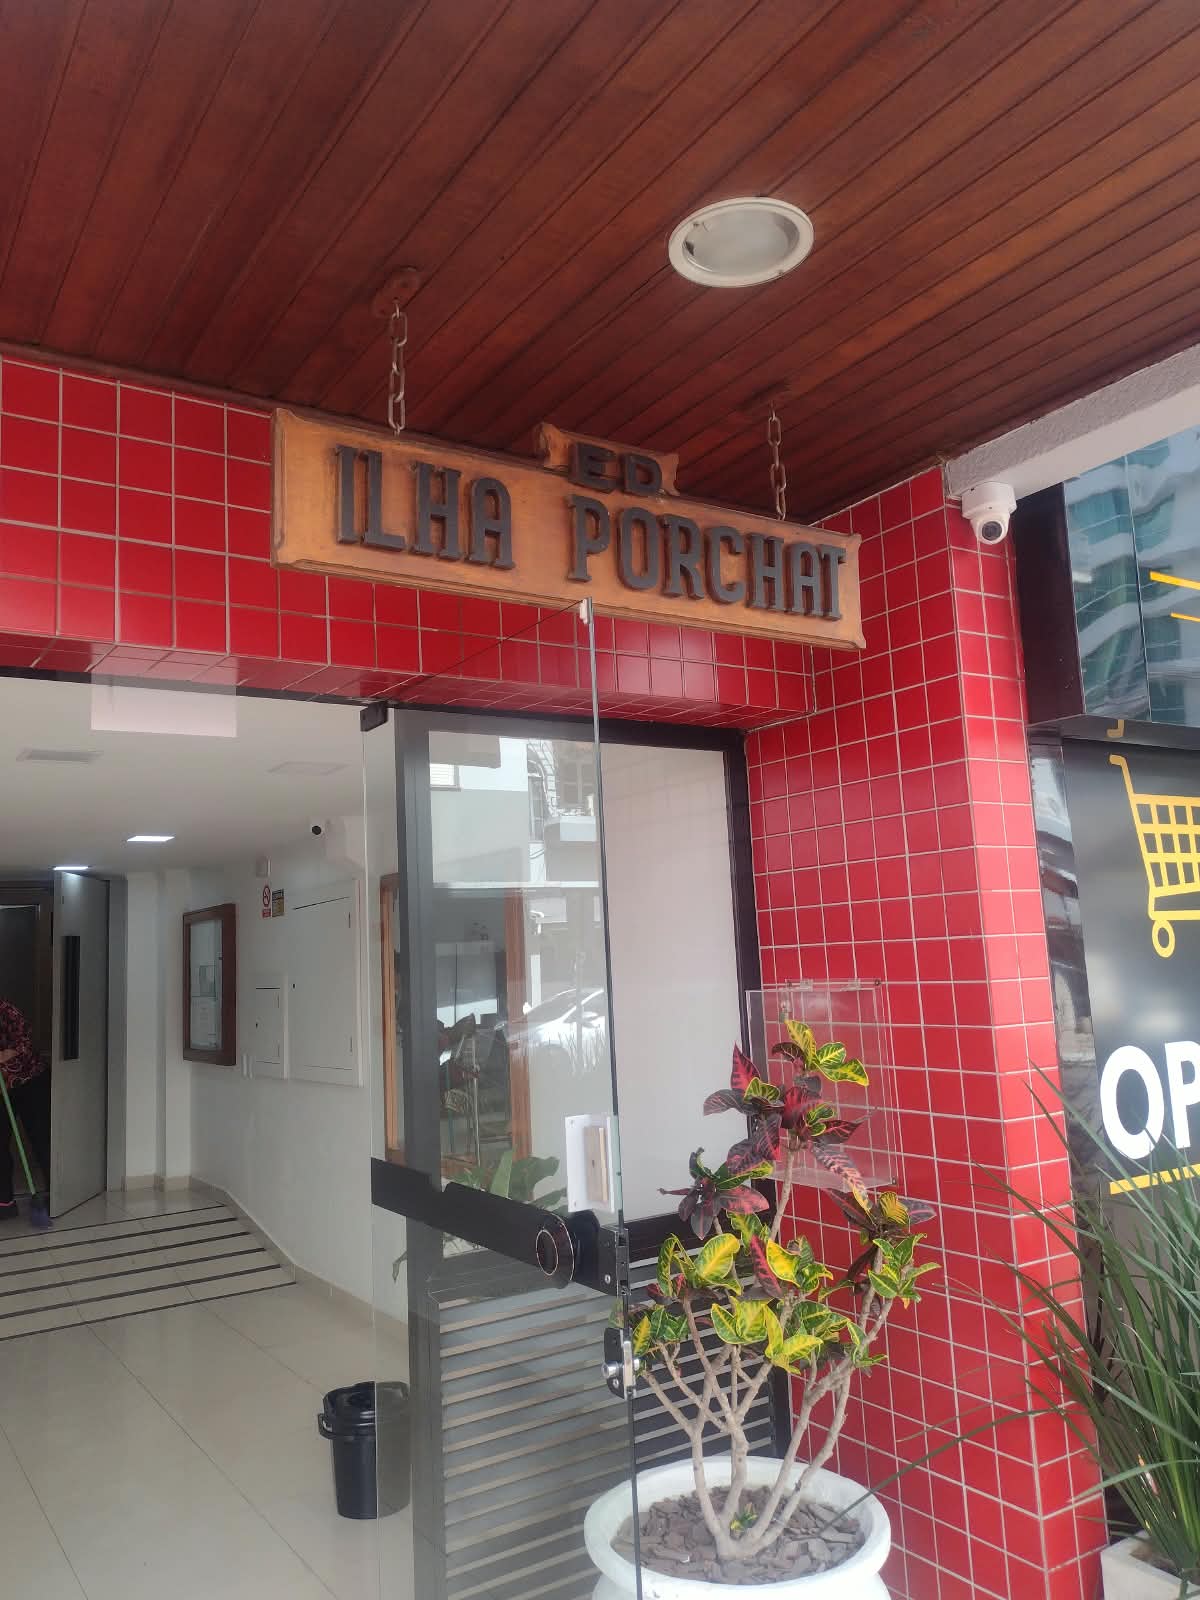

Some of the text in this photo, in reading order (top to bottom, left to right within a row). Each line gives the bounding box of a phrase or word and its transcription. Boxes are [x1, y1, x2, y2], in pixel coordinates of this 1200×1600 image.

[568, 443, 663, 496] ED
[336, 444, 846, 620] ILHA PORCHAT
